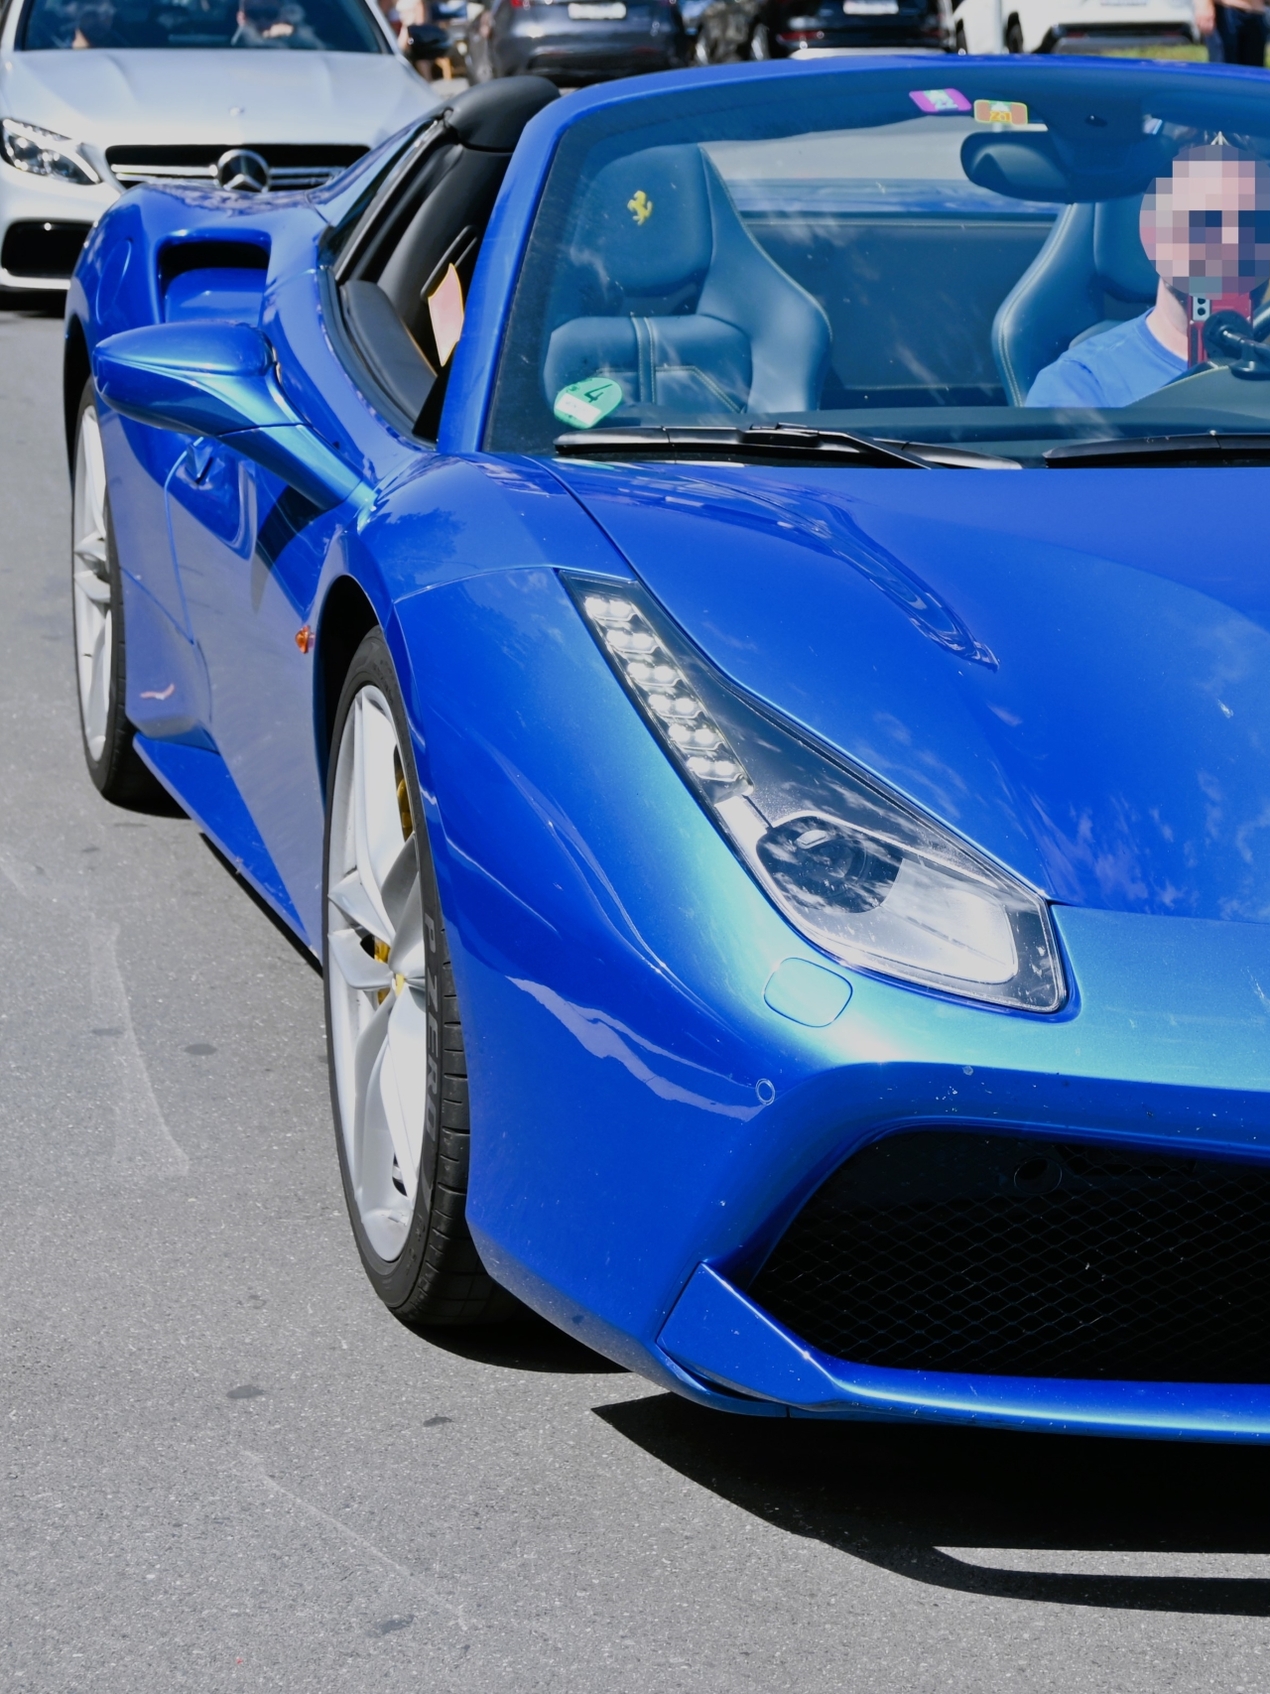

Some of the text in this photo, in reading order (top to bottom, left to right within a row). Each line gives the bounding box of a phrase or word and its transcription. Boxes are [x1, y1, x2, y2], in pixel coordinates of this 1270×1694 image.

[584, 383, 613, 404] 4
[424, 912, 439, 1142] P ZERO
